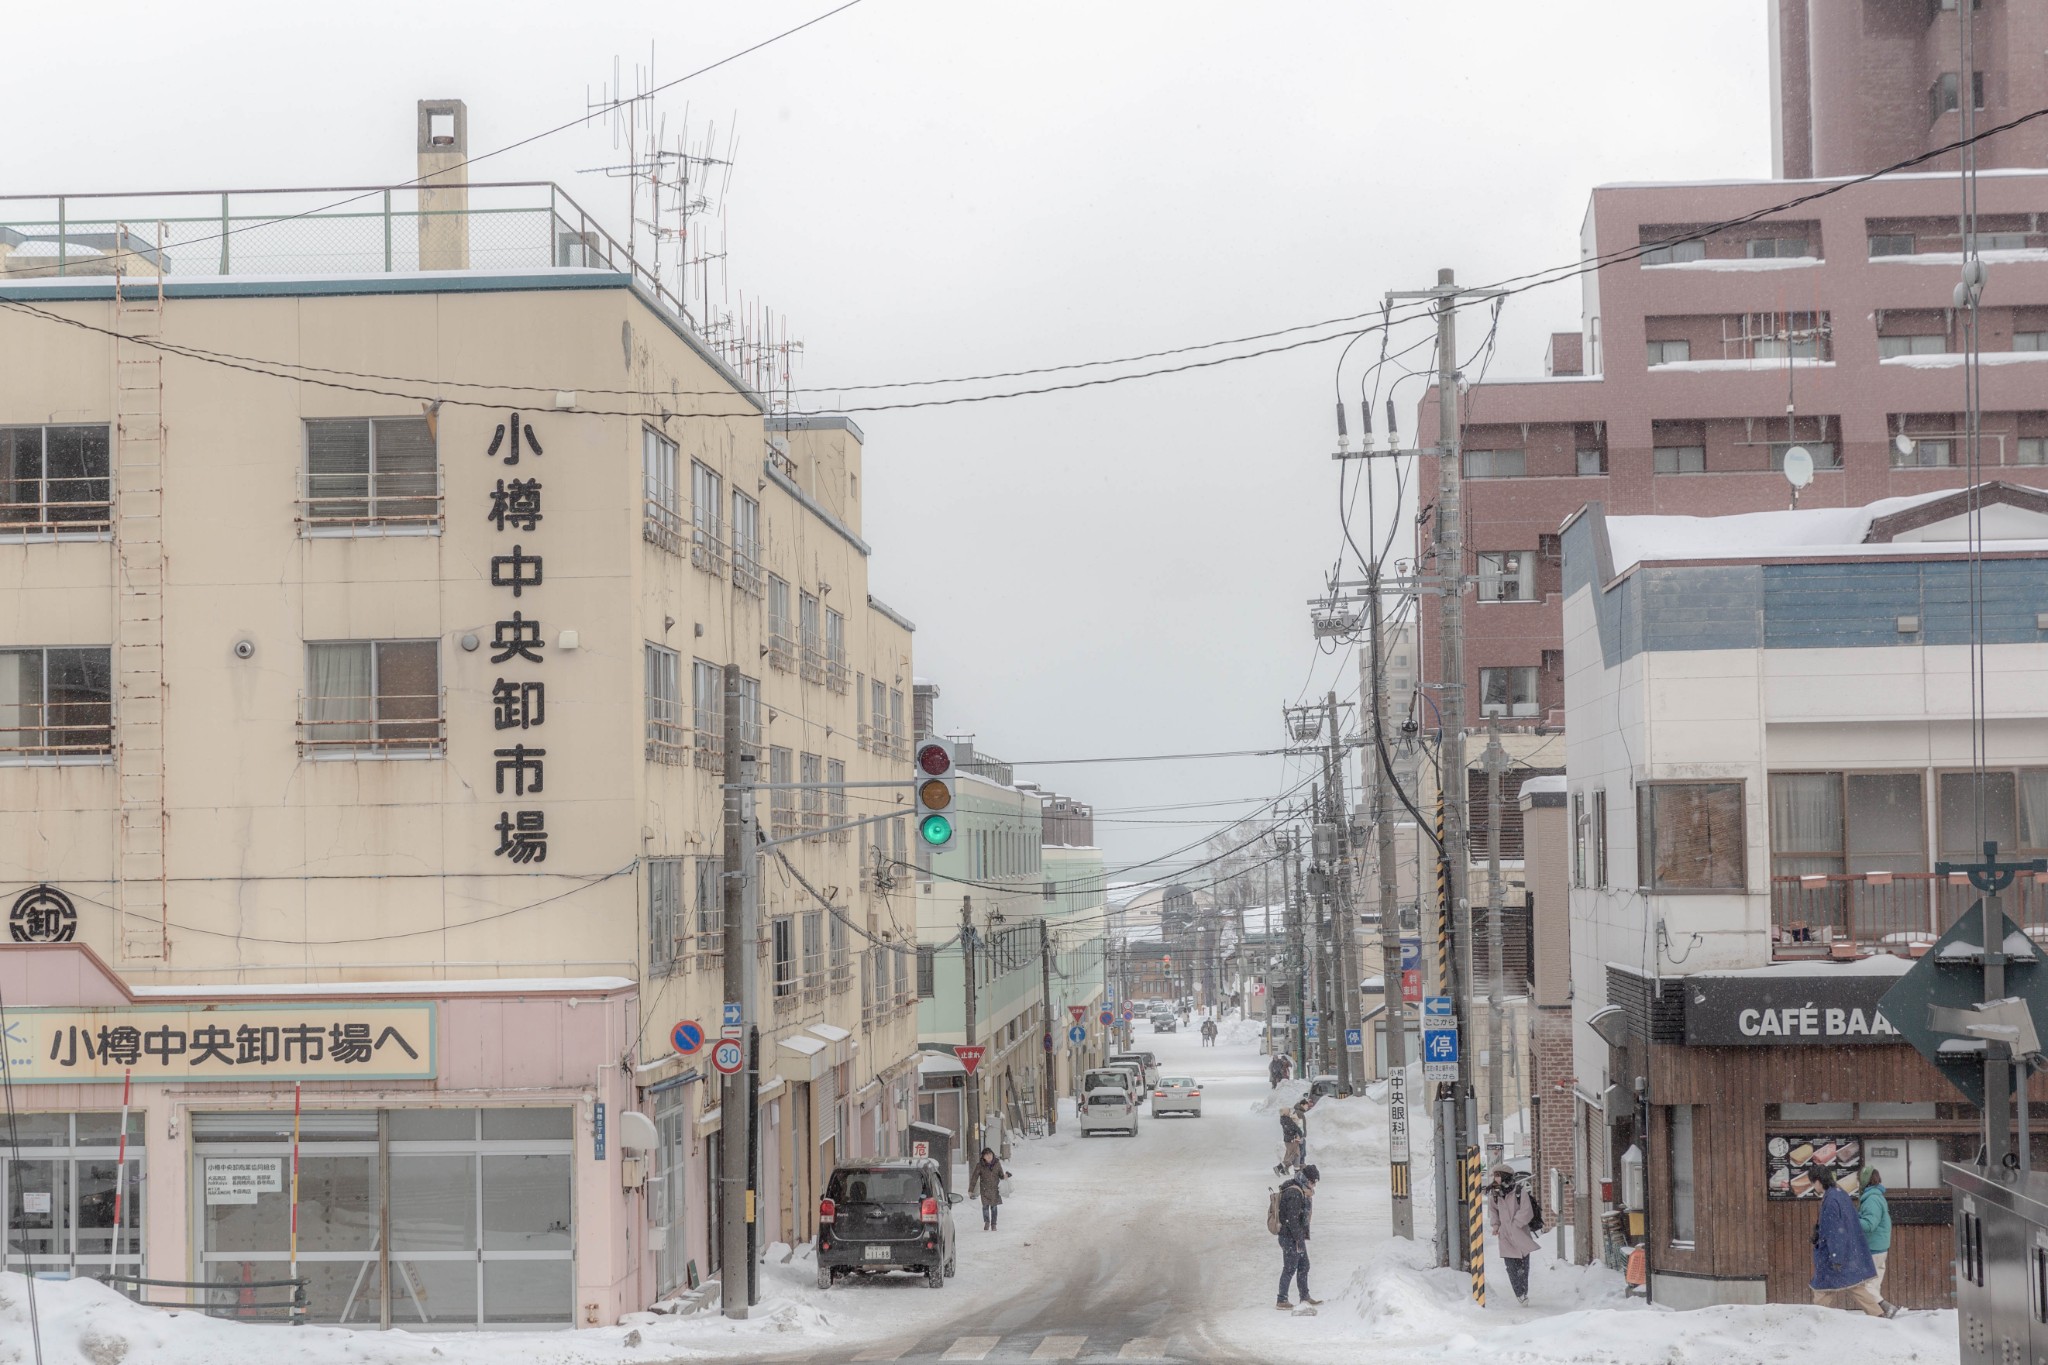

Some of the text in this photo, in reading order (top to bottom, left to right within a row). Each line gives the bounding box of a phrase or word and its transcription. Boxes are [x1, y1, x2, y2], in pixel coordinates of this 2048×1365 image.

[487, 412, 549, 865] 小樽中央卸市場
[26, 906, 61, 938] 卸
[1425, 1018, 1456, 1027] ここから
[1739, 1001, 1901, 1036] CAFÉ BAA
[50, 1022, 419, 1067] 小樽中央卸市場へ
[720, 1048, 739, 1064] 30
[961, 1051, 981, 1059] 止まれ
[1429, 1035, 1453, 1057] 停
[1391, 1076, 1405, 1135] 中央眼科
[914, 1143, 927, 1157] 危
